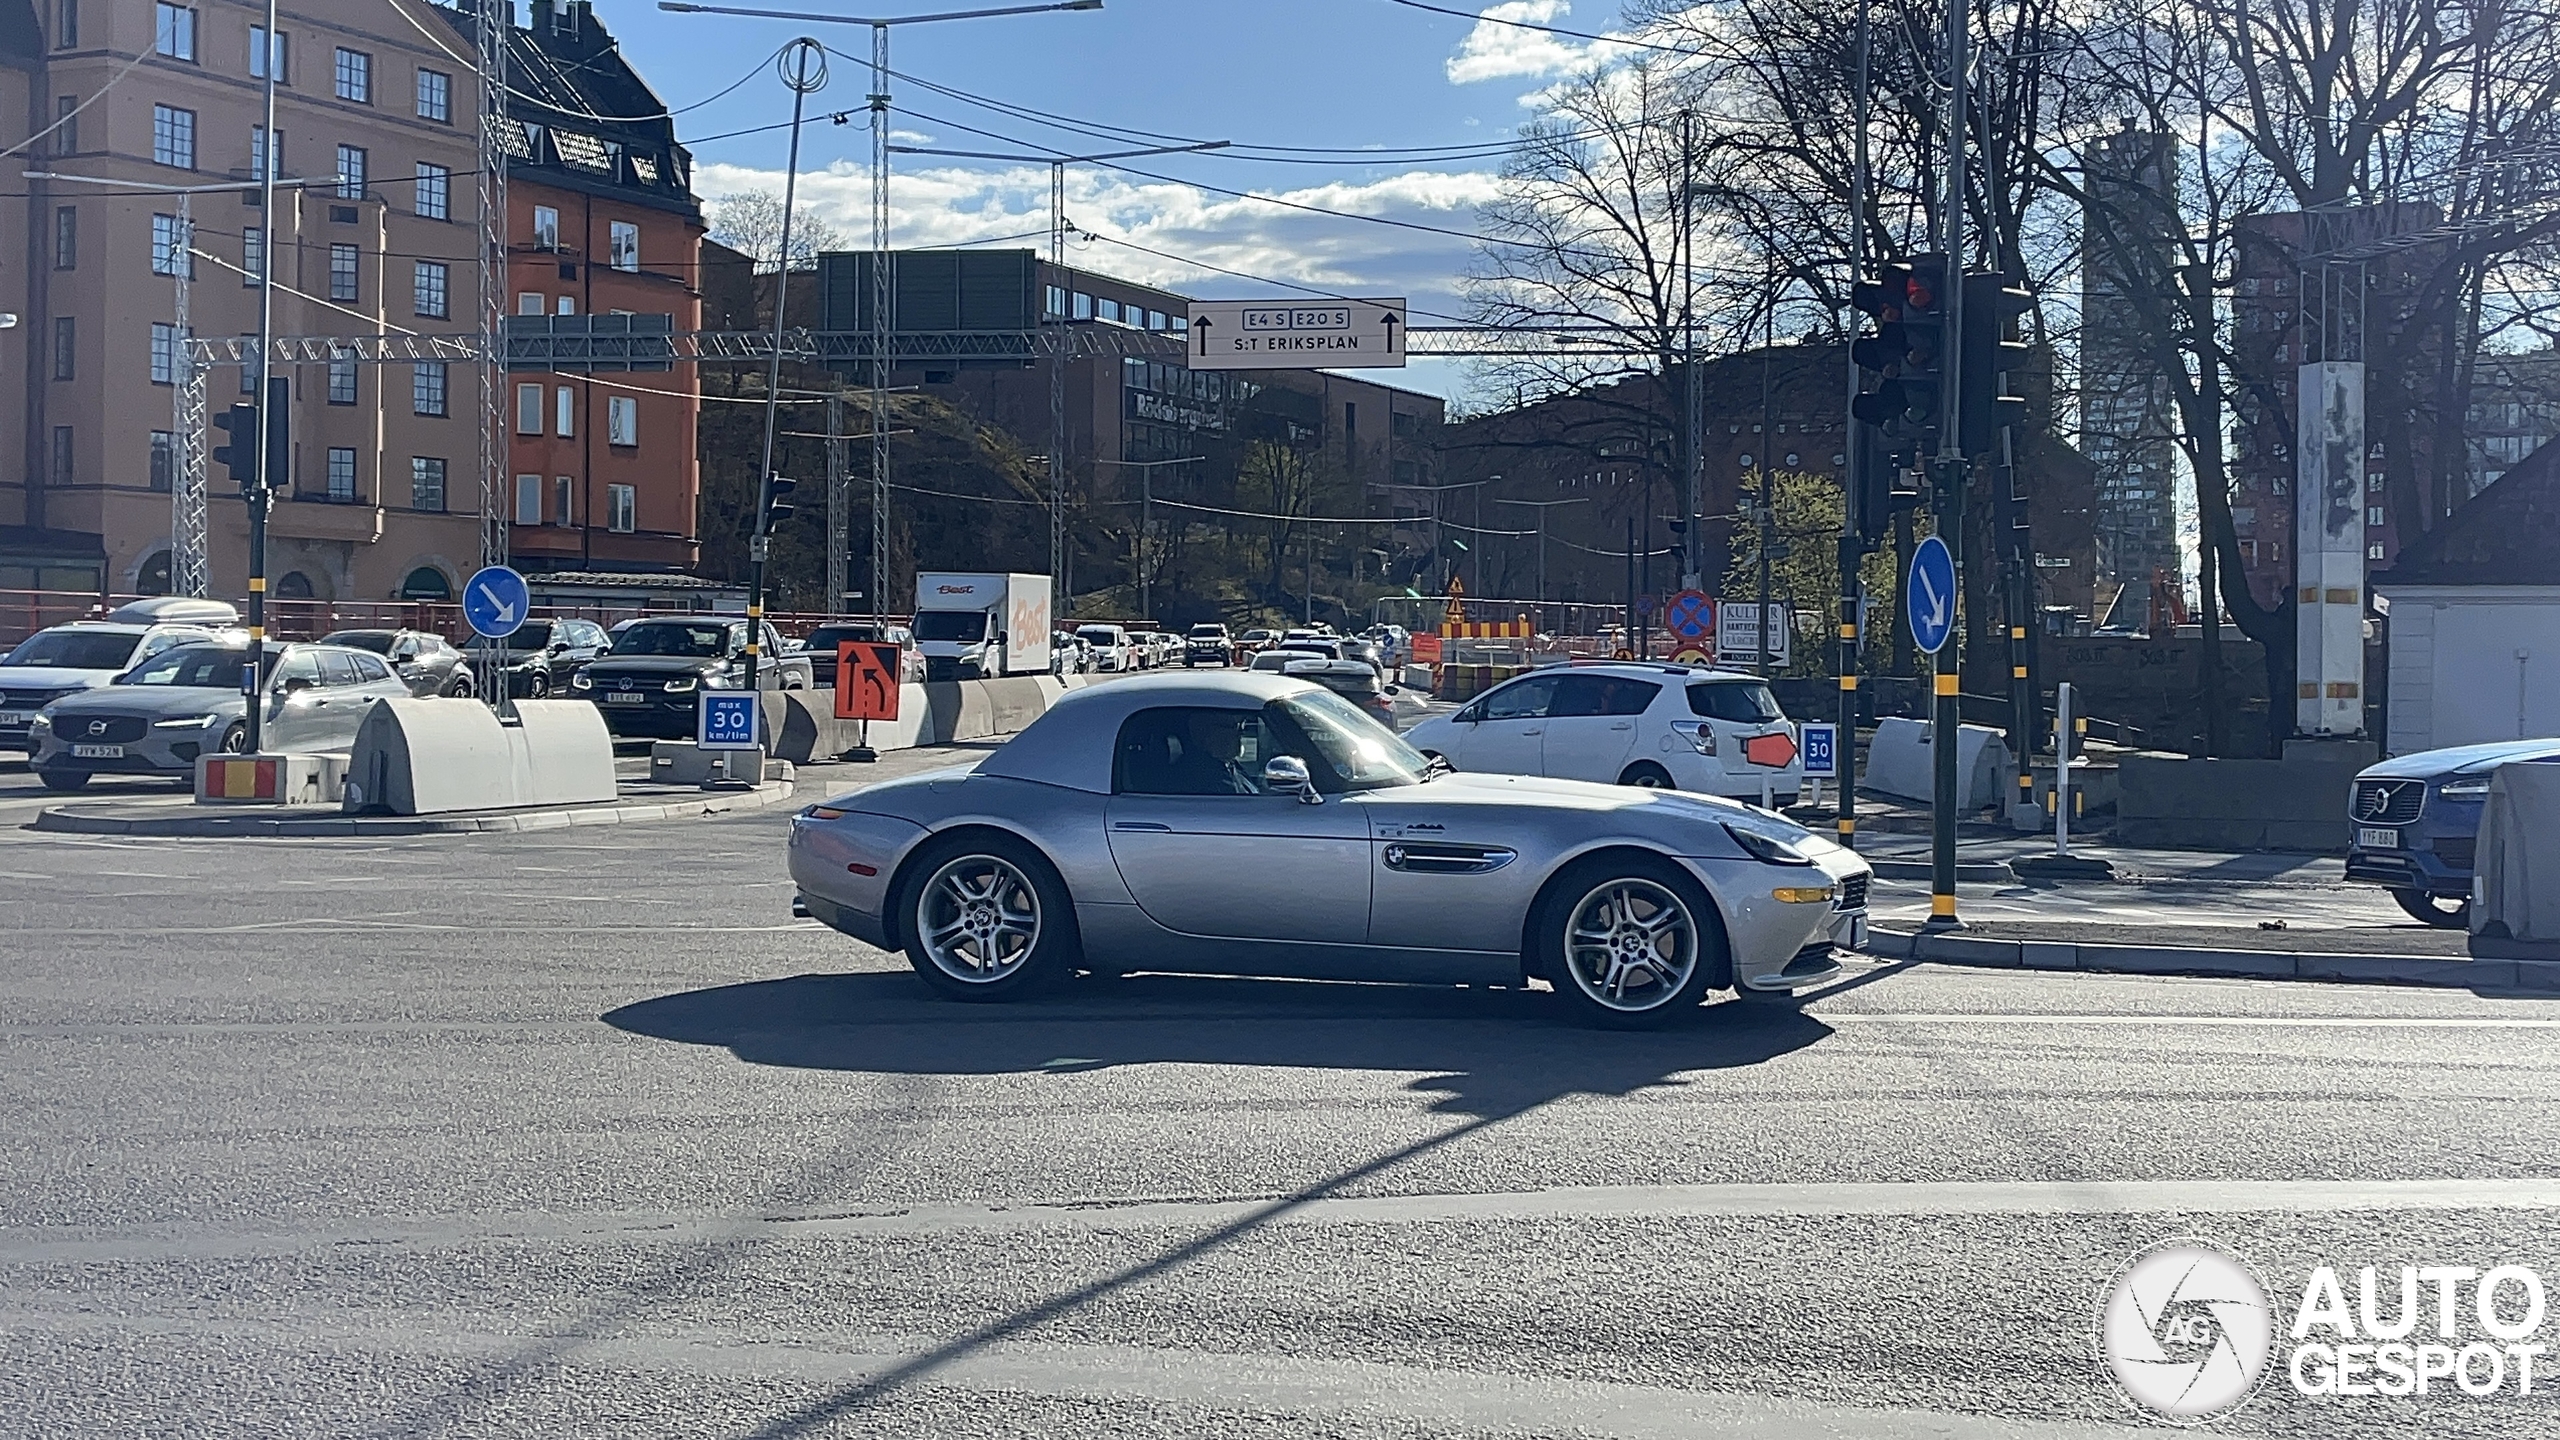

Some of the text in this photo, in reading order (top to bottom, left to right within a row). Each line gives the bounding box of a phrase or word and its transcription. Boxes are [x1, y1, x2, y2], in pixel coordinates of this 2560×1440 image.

[1249, 312, 1345, 326] E4 S E20 S
[1234, 336, 1358, 351] S:T ERIKSPLAN
[936, 584, 975, 594] Best
[1726, 605, 1778, 619] KULTR
[1012, 595, 1048, 652] Best
[714, 711, 745, 728] 30
[1809, 742, 1829, 758] 30
